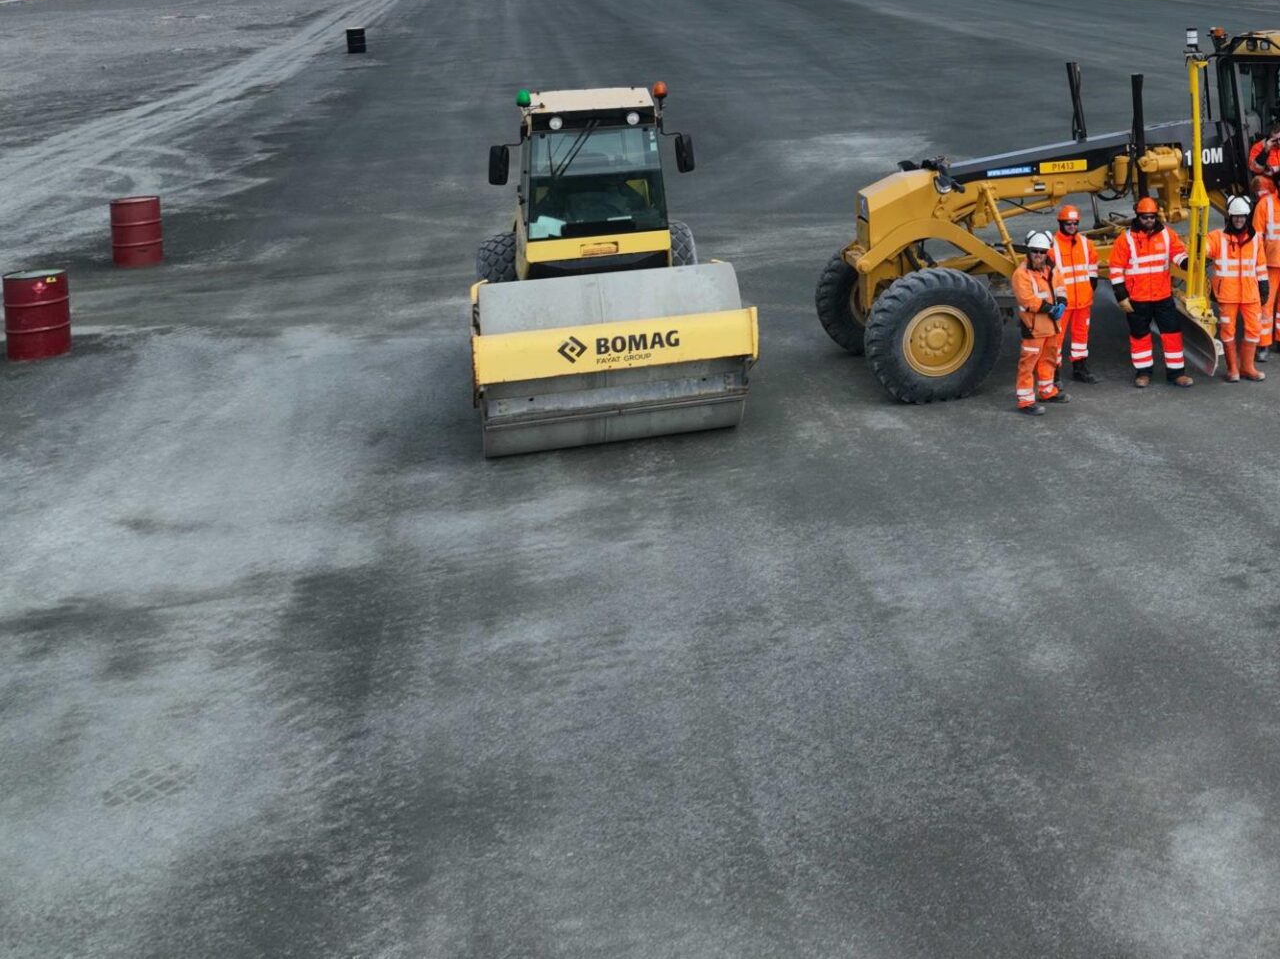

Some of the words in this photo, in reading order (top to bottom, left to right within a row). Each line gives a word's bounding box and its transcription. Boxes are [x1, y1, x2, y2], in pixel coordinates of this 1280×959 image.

[1185, 147, 1223, 166] 10M
[596, 330, 680, 355] BOMAG
[597, 356, 621, 365] FAYAT
[624, 352, 651, 361] GROUP
